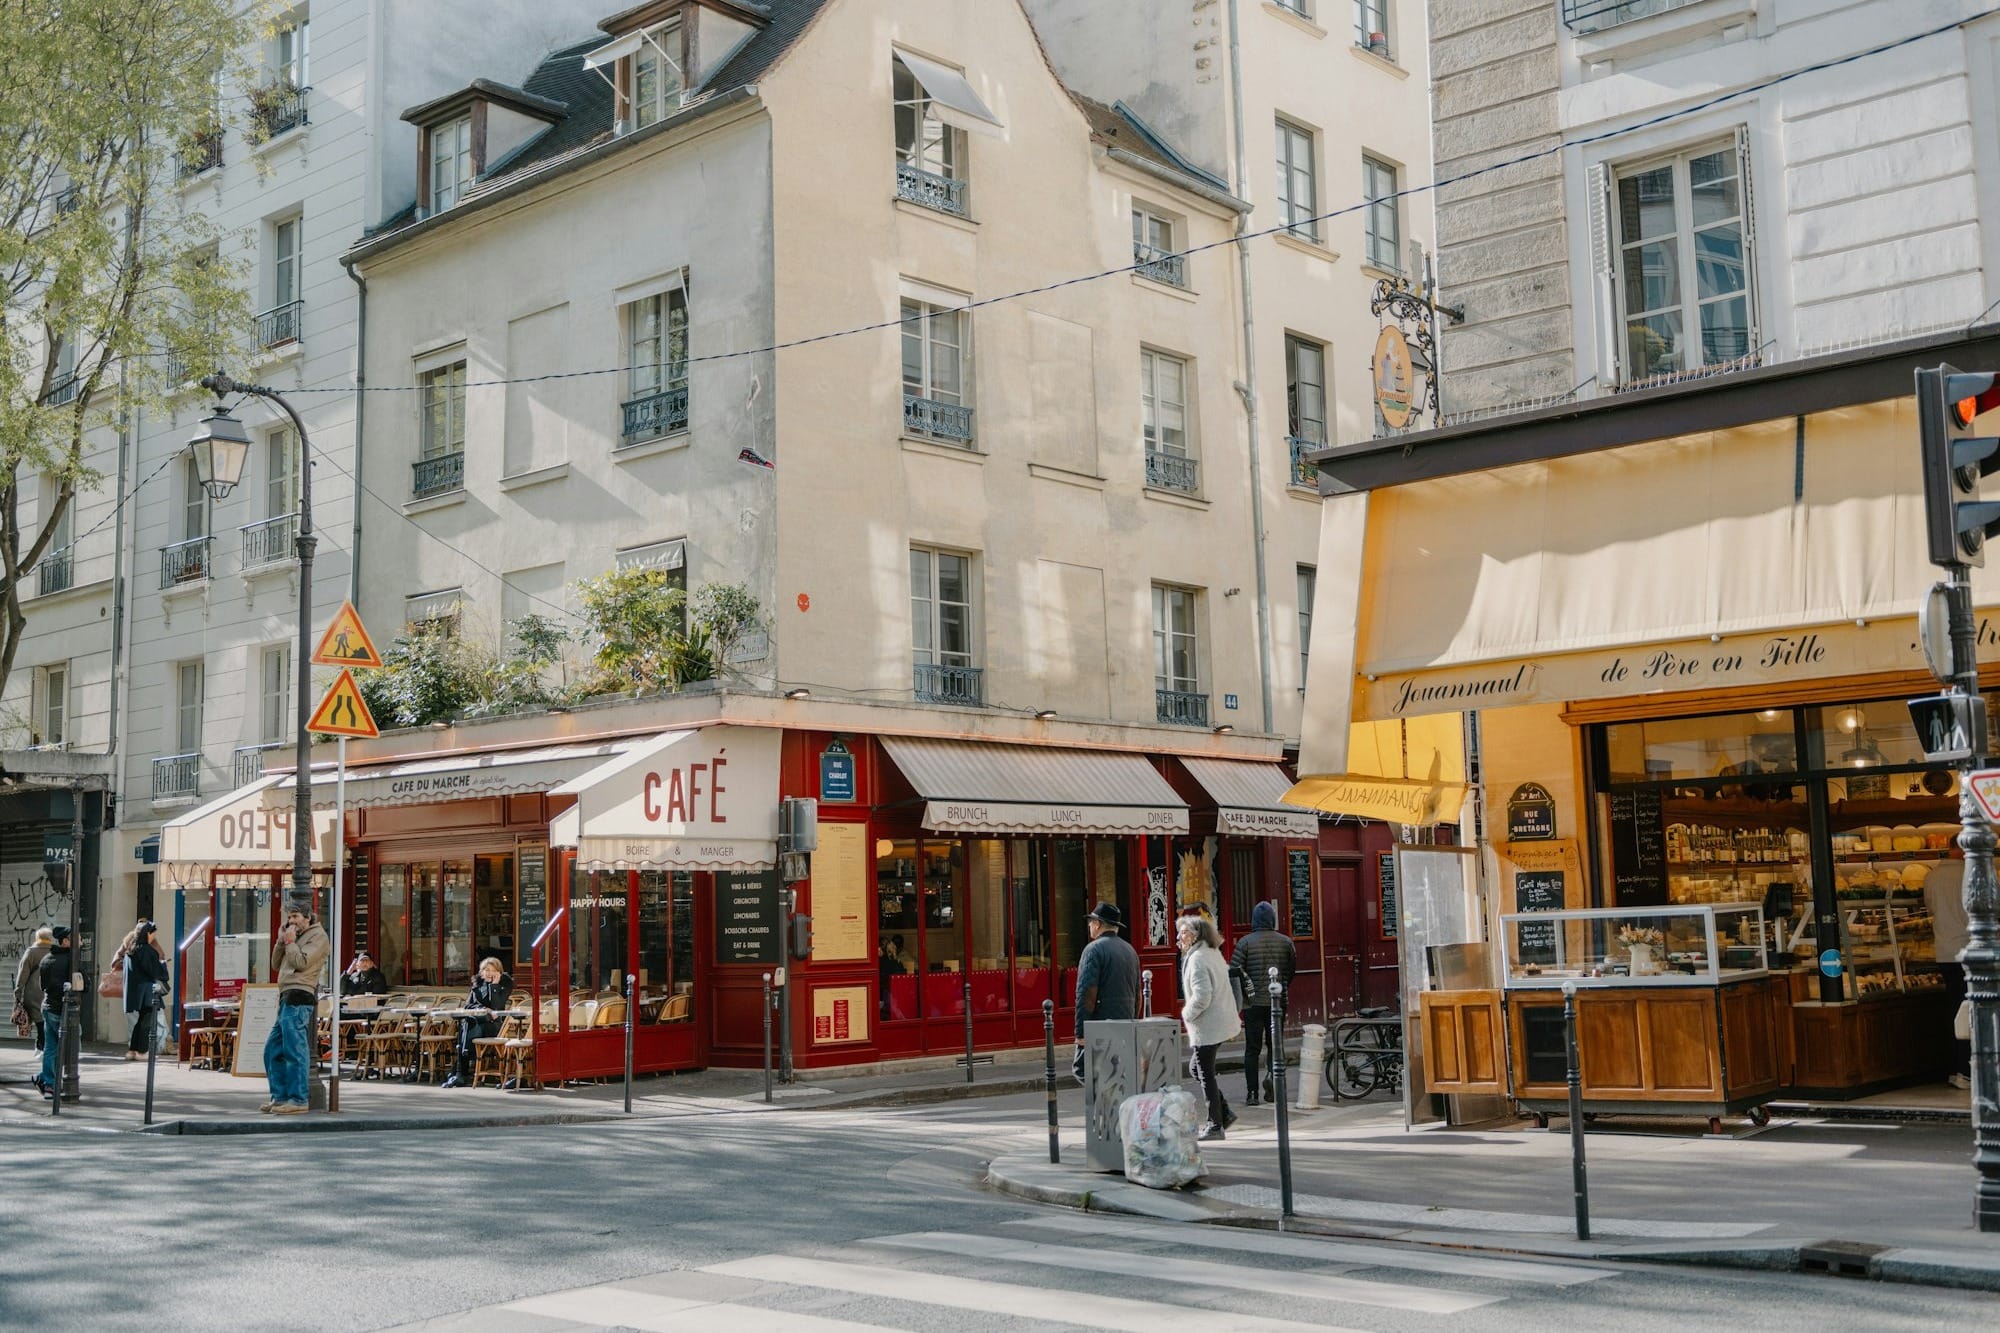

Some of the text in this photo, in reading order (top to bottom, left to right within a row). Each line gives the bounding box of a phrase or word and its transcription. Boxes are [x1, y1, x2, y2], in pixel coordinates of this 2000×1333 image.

[1601, 634, 1826, 683] de Père en Fille
[1225, 696, 1238, 708] 44
[392, 781, 414, 793] CAFE
[417, 780, 430, 791] DU
[432, 775, 471, 790] MARCHE
[644, 748, 728, 823] CAFÉ
[947, 806, 988, 820] BRUNCH
[1051, 809, 1082, 822] LUNCH
[1147, 812, 1174, 824] DINER
[1524, 810, 1539, 818] RUE
[1225, 813, 1244, 823] CAFE
[1246, 814, 1256, 824] DU
[1258, 816, 1288, 826] MARCHE
[1513, 824, 1551, 833] BRETAGNE
[626, 845, 734, 856] BOIRE & MANGER
[570, 897, 626, 908] HAPPY HOURS
